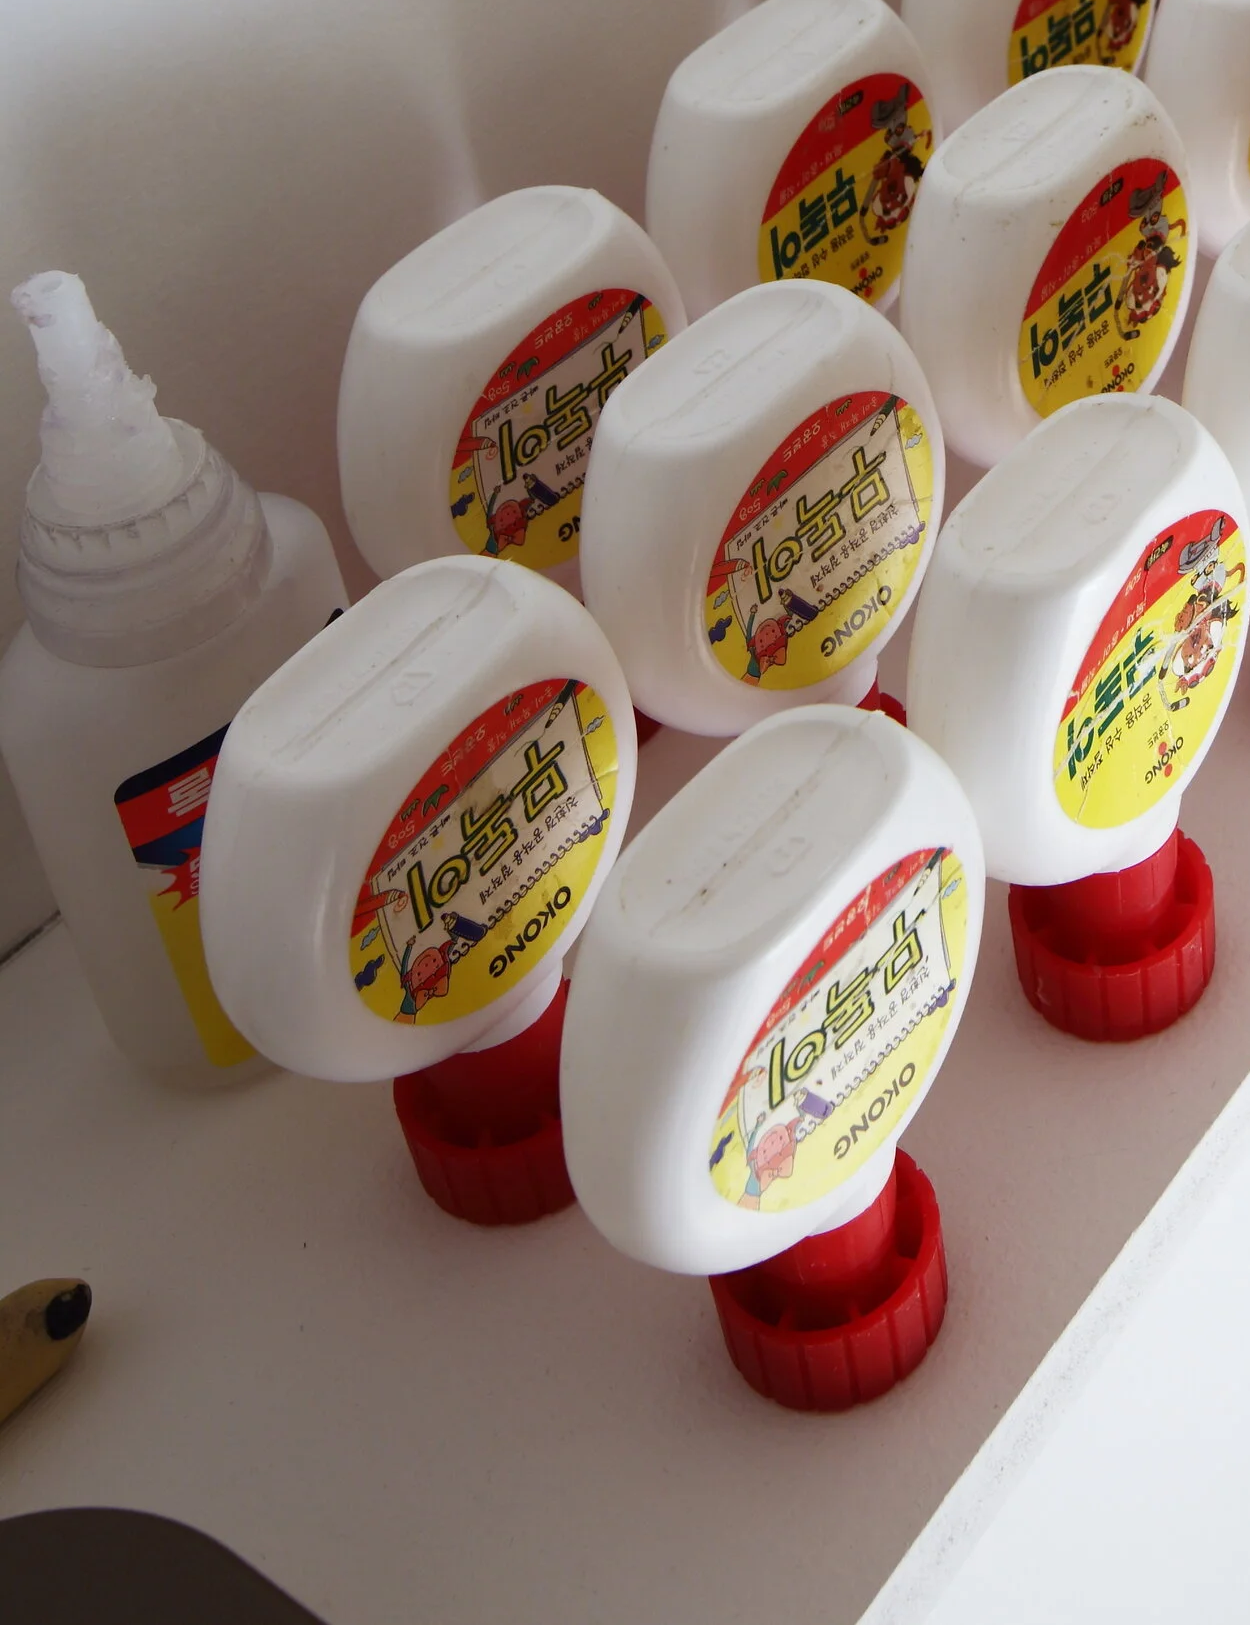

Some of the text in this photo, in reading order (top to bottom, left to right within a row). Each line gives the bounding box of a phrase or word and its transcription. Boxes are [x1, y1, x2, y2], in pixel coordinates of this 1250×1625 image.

[770, 169, 859, 280] 무독이
[851, 266, 882, 297] OKON
[1029, 264, 1115, 380] 무독이
[781, 420, 825, 463] 오공본드
[752, 448, 891, 604] 무독이
[808, 503, 900, 587] 친환경 공작용 접착제
[821, 585, 891, 659] OKONG
[1067, 630, 1159, 781] 무독이
[1102, 726, 1125, 753] 수성
[1123, 693, 1154, 729] 공작용
[1145, 737, 1184, 784] OKONG
[386, 821, 418, 849] 50g
[407, 836, 429, 860] 건조
[408, 740, 569, 932] 무독이
[426, 814, 452, 841] 빠른
[476, 795, 579, 905] 친환경 공작용 접착제
[488, 888, 572, 978] OKONG
[770, 912, 926, 1110] 무독이
[832, 1062, 915, 1161] OKONG
